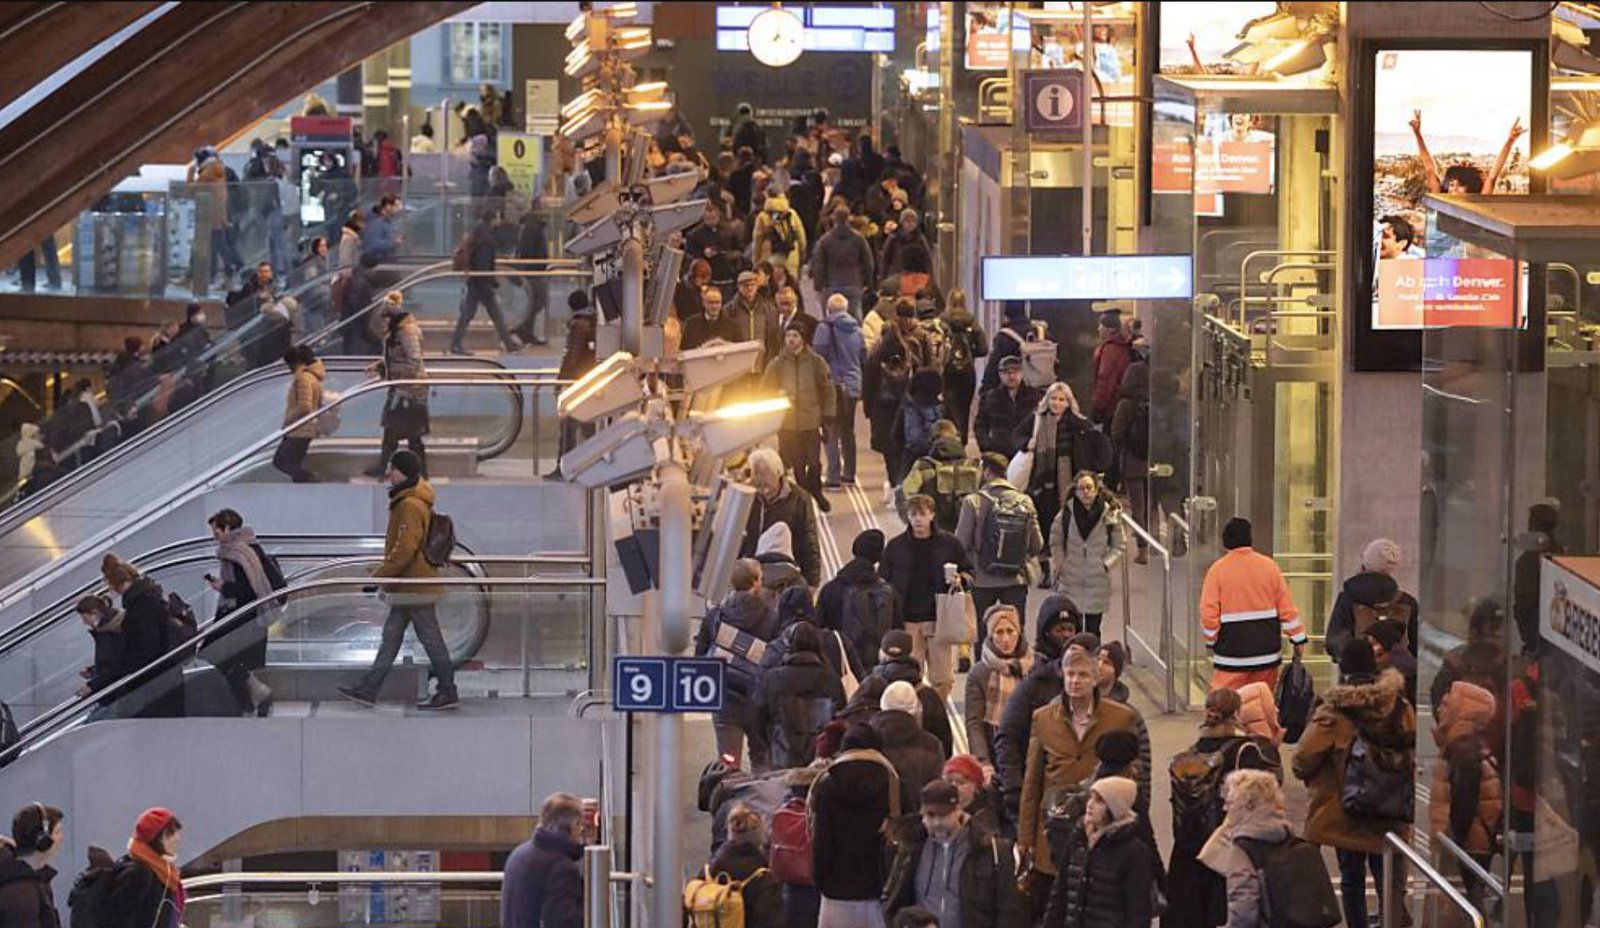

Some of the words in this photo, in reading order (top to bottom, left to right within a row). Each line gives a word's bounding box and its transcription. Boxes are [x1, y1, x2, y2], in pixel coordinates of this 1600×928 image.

[1564, 599, 1600, 662] BREZE
[630, 674, 652, 702] 9
[680, 675, 716, 703] 10
